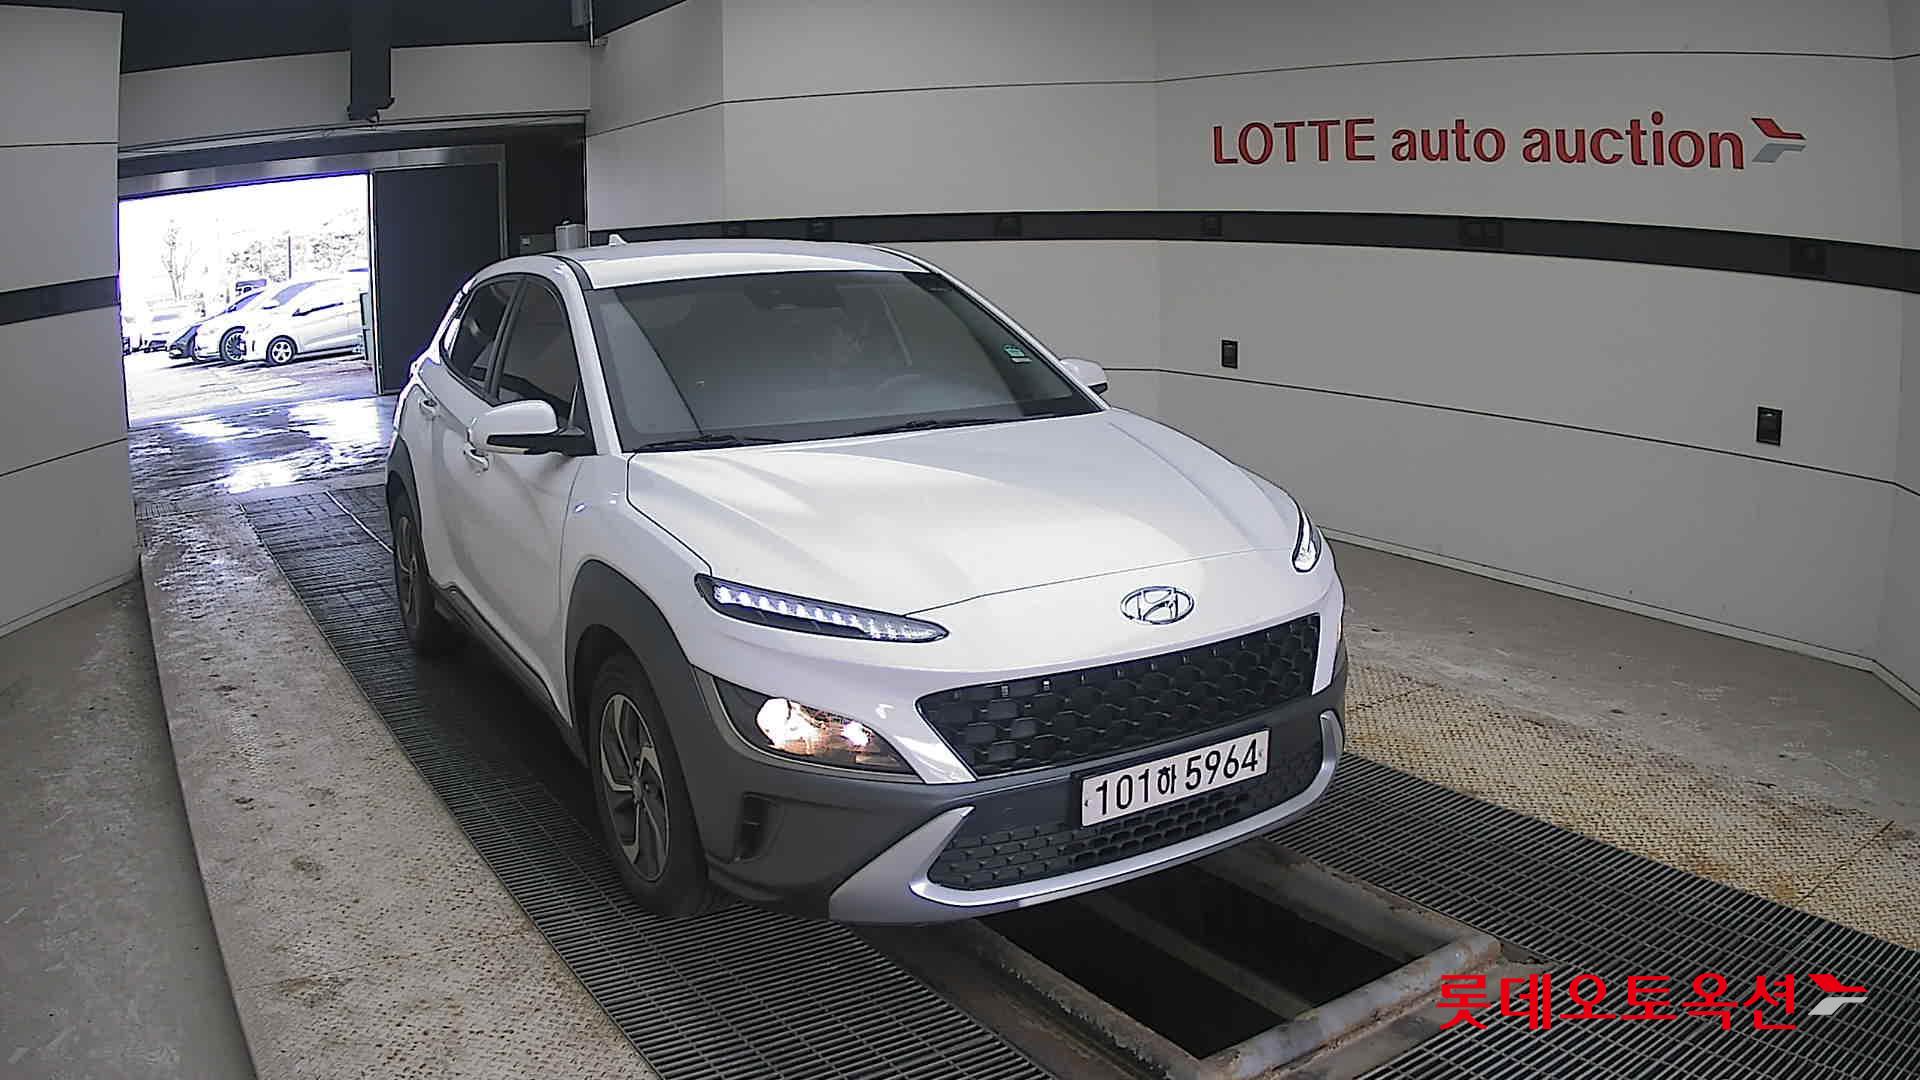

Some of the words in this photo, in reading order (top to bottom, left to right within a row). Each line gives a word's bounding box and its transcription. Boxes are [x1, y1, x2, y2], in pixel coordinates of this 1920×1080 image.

[1213, 118, 1375, 164] LOTTE
[1392, 120, 1506, 162] auto
[1523, 111, 1744, 169] auction
[1096, 764, 1176, 815] 101하
[1185, 739, 1258, 790] 5964
